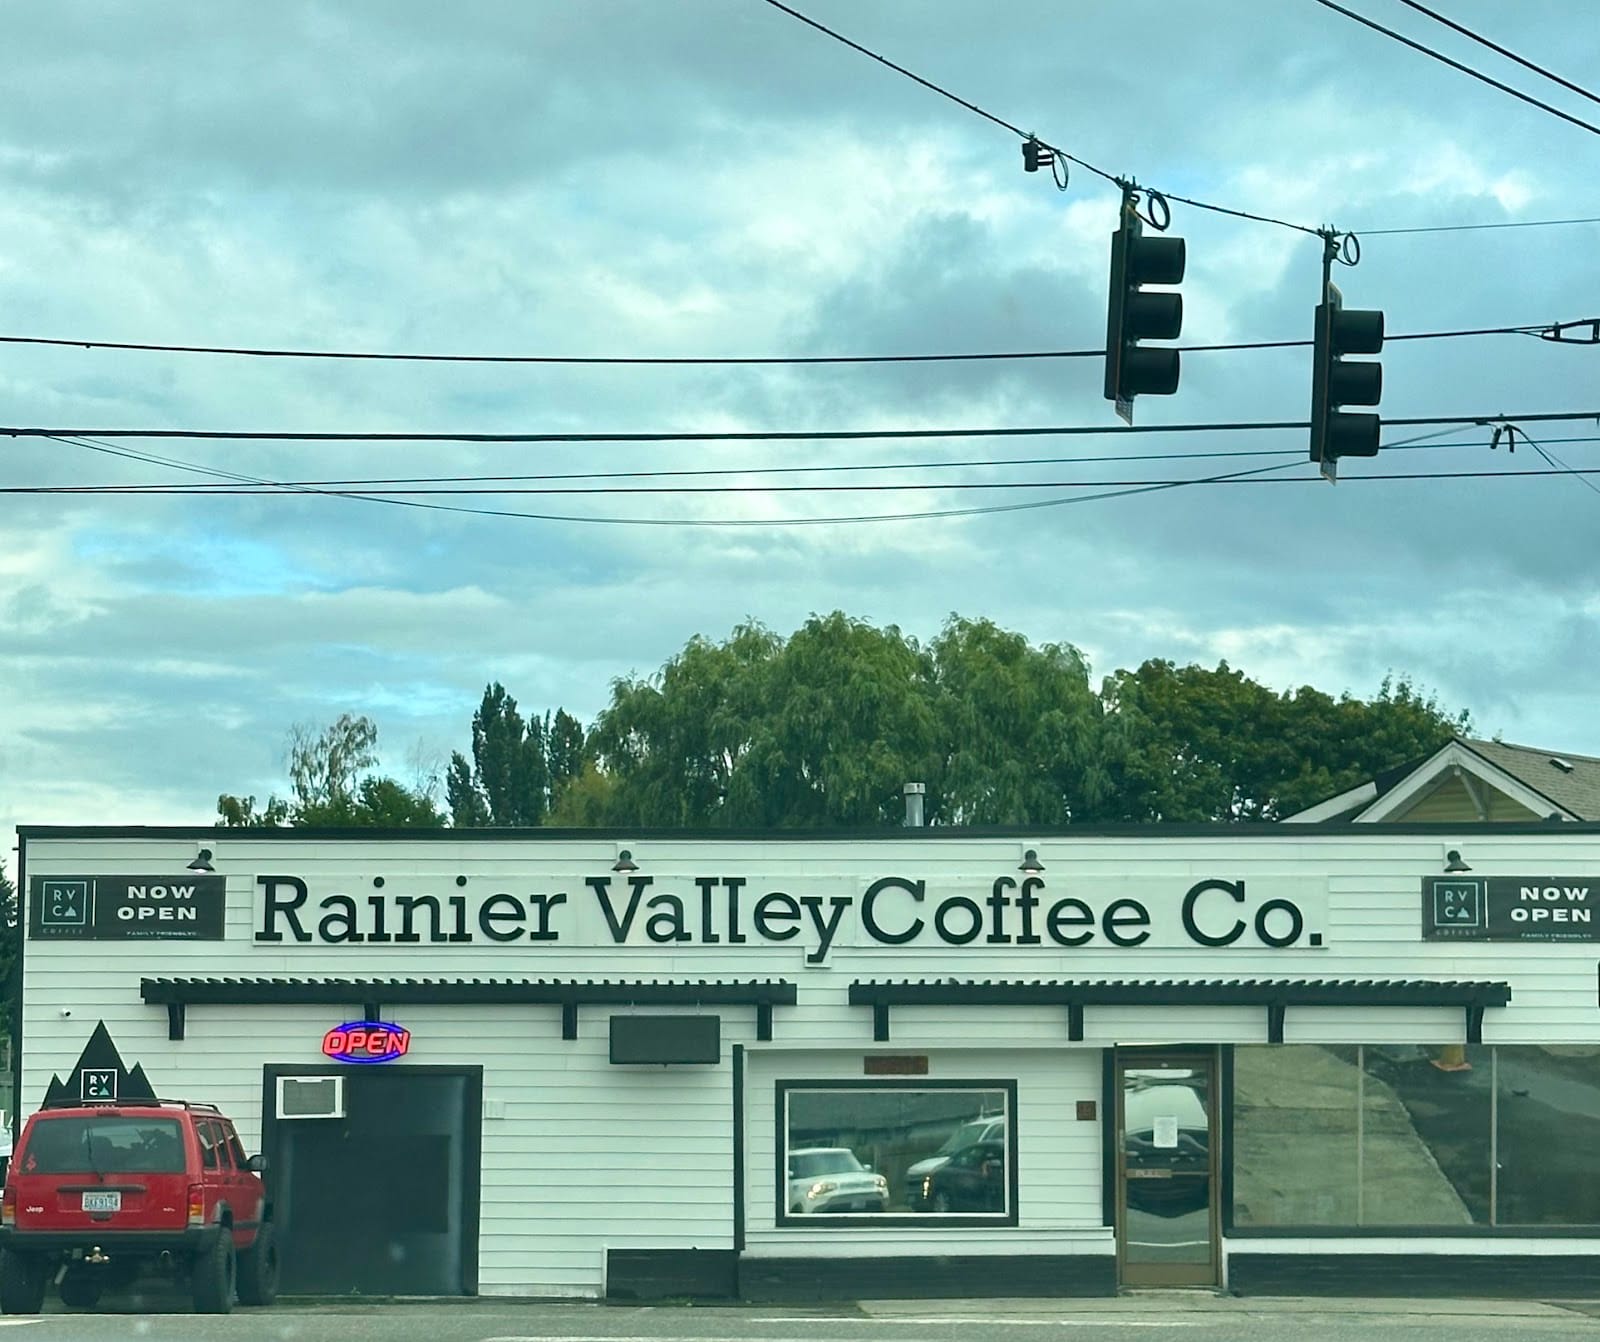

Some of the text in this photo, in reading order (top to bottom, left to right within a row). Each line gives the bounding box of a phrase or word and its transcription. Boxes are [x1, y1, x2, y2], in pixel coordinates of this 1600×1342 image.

[127, 886, 196, 899] NOW
[1520, 886, 1589, 900] NOW
[117, 906, 197, 920] OPEN
[254, 875, 1322, 963] Rainier Valley Coffee Co.
[1510, 908, 1591, 922] OPEN
[324, 1031, 409, 1055] OPEN
[25, 1205, 45, 1214] Jeep
